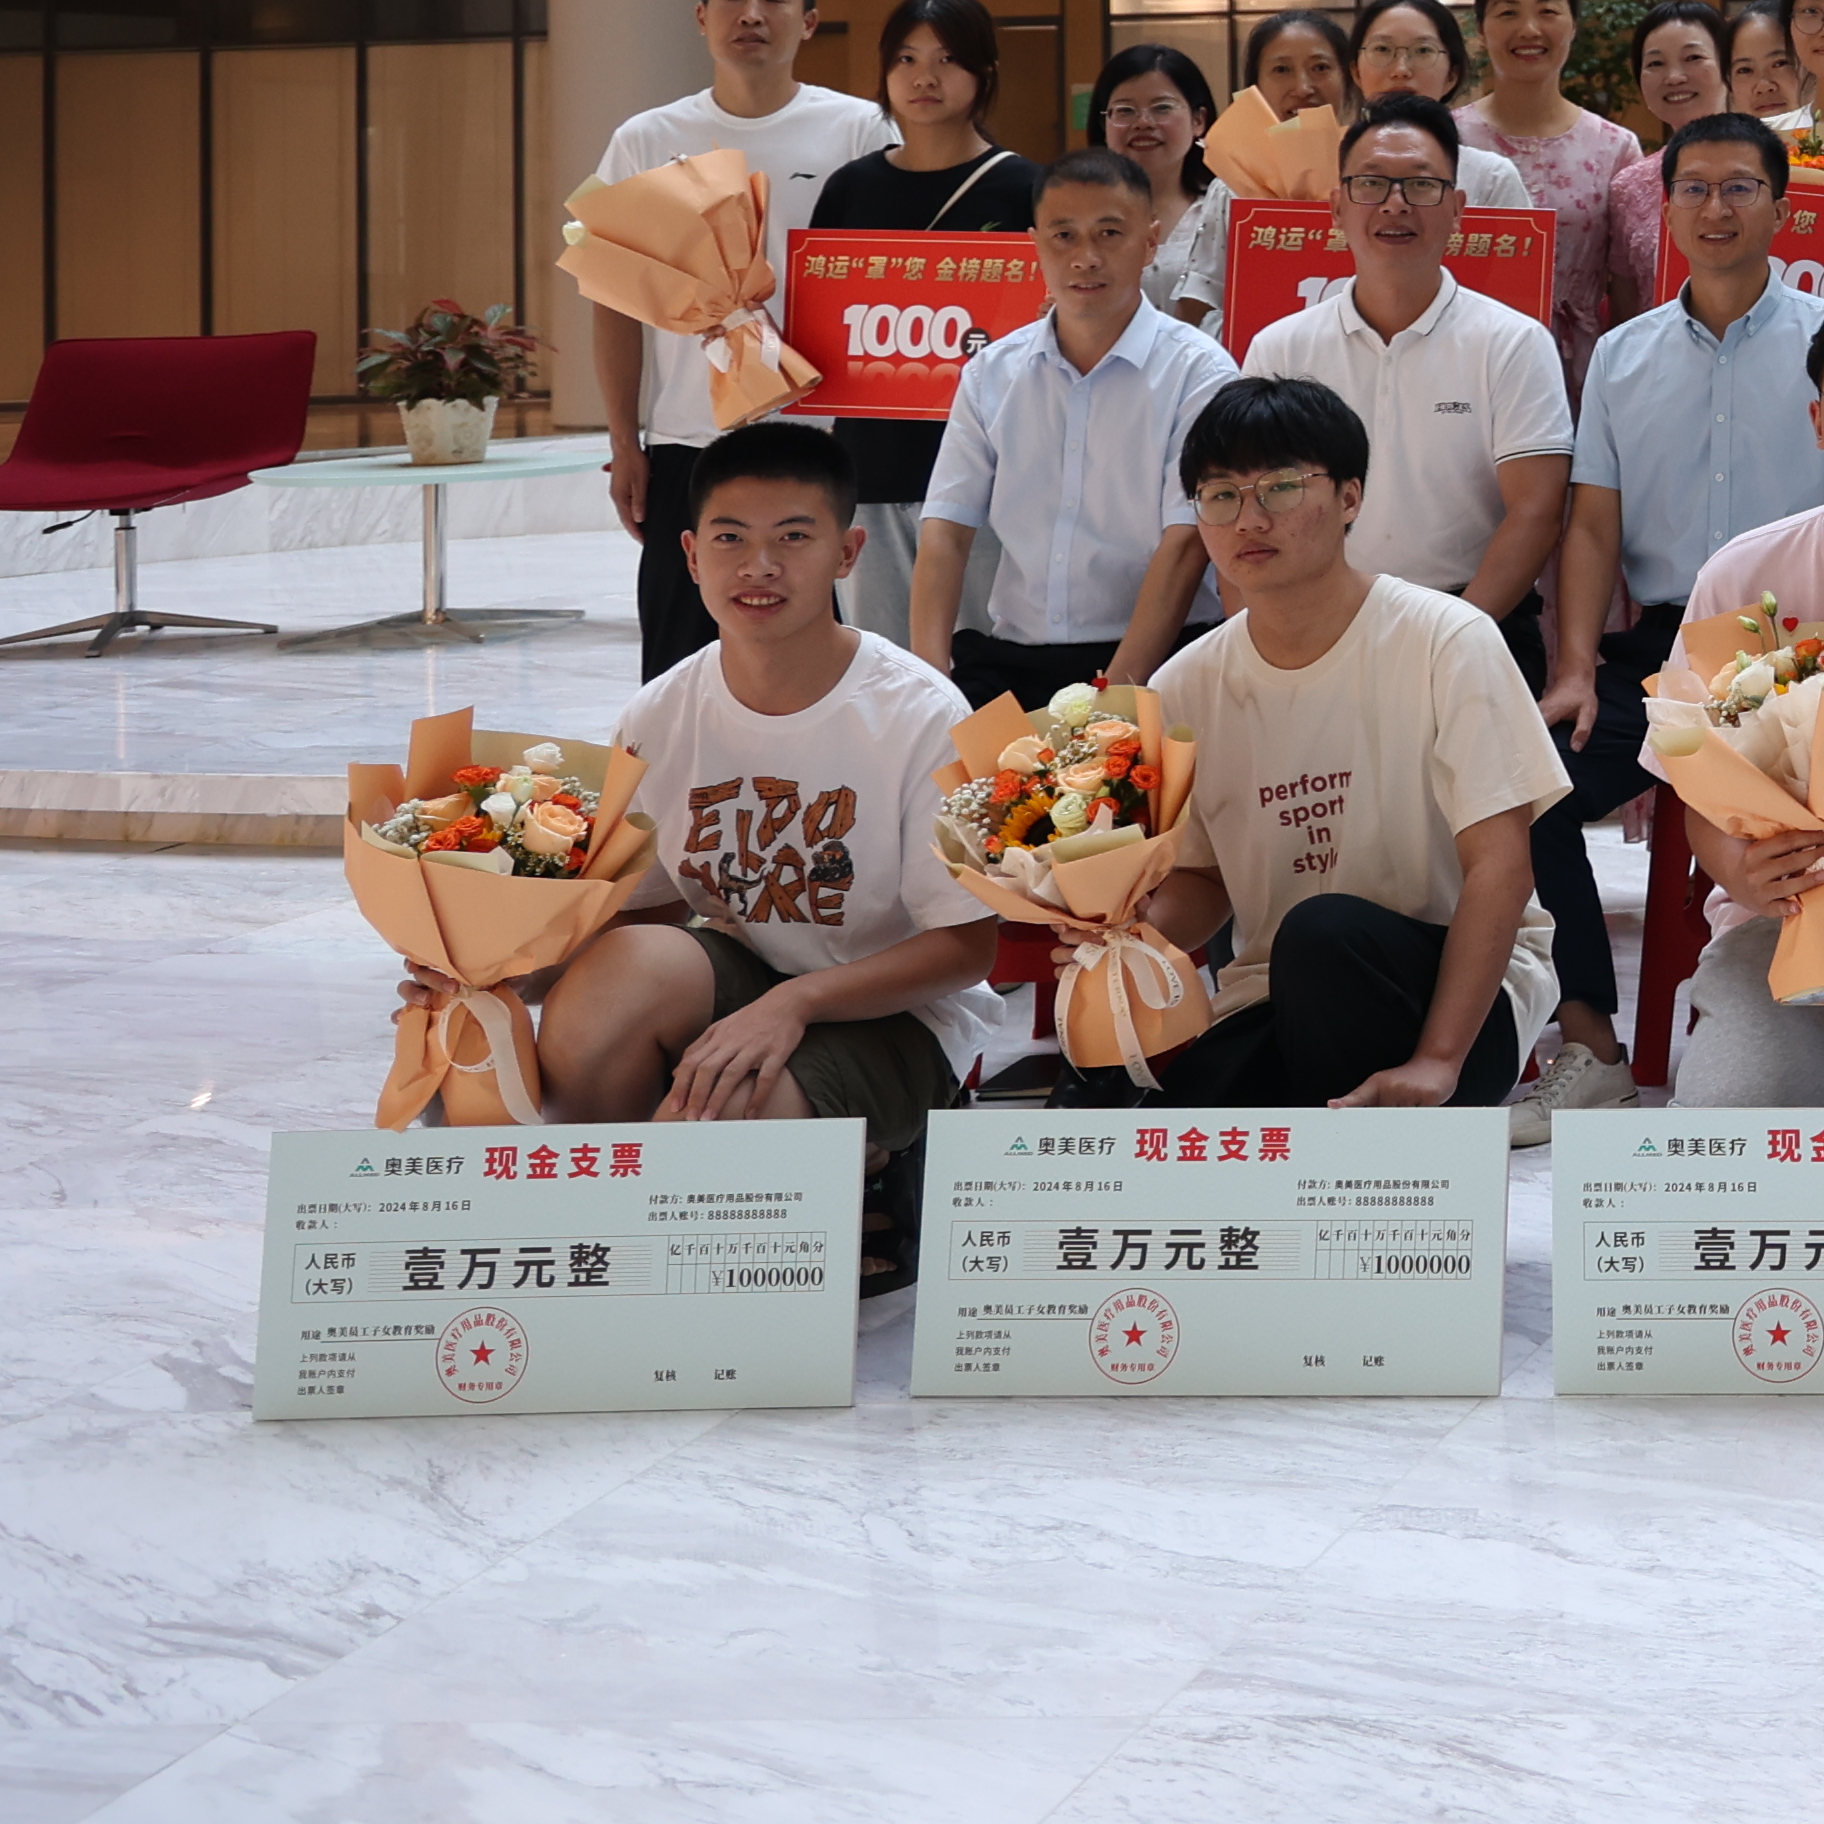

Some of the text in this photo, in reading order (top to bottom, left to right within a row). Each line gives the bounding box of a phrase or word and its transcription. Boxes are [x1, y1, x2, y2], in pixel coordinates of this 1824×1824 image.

[1248, 225, 1533, 258] 鸿运“罩 榜题名!
[803, 254, 1040, 283] 鸿运“罩”您 金榜题名!
[843, 304, 973, 360] 1000
[1278, 794, 1346, 828] sport
[1306, 825, 1332, 846] in
[1036, 1135, 1117, 1156] 奥美医疗
[1133, 1125, 1292, 1162] 现金支票
[1665, 1136, 1748, 1157] 奥美医疗
[382, 1154, 465, 1177] 奥美医疗
[481, 1141, 643, 1181] 现金支票
[1031, 1179, 1123, 1193] 2024年8月16日
[1333, 1178, 1450, 1190] 奥美医疗用品股份有限公司
[1663, 1180, 1757, 1193] 2024年8月16日
[377, 1198, 471, 1213] 2024年8月16日
[686, 1190, 803, 1204] 奥美医疗用品股份有限公司
[960, 1229, 1012, 1248] 人民币
[1055, 1224, 1261, 1271] 壹万元整
[1594, 1229, 1646, 1248] 人民币
[304, 1251, 357, 1270] 人民币
[401, 1241, 612, 1291] 壹万元整
[961, 1254, 1009, 1273] (大写)
[1596, 1254, 1645, 1274] (大写)
[304, 1276, 353, 1296] (大写)
